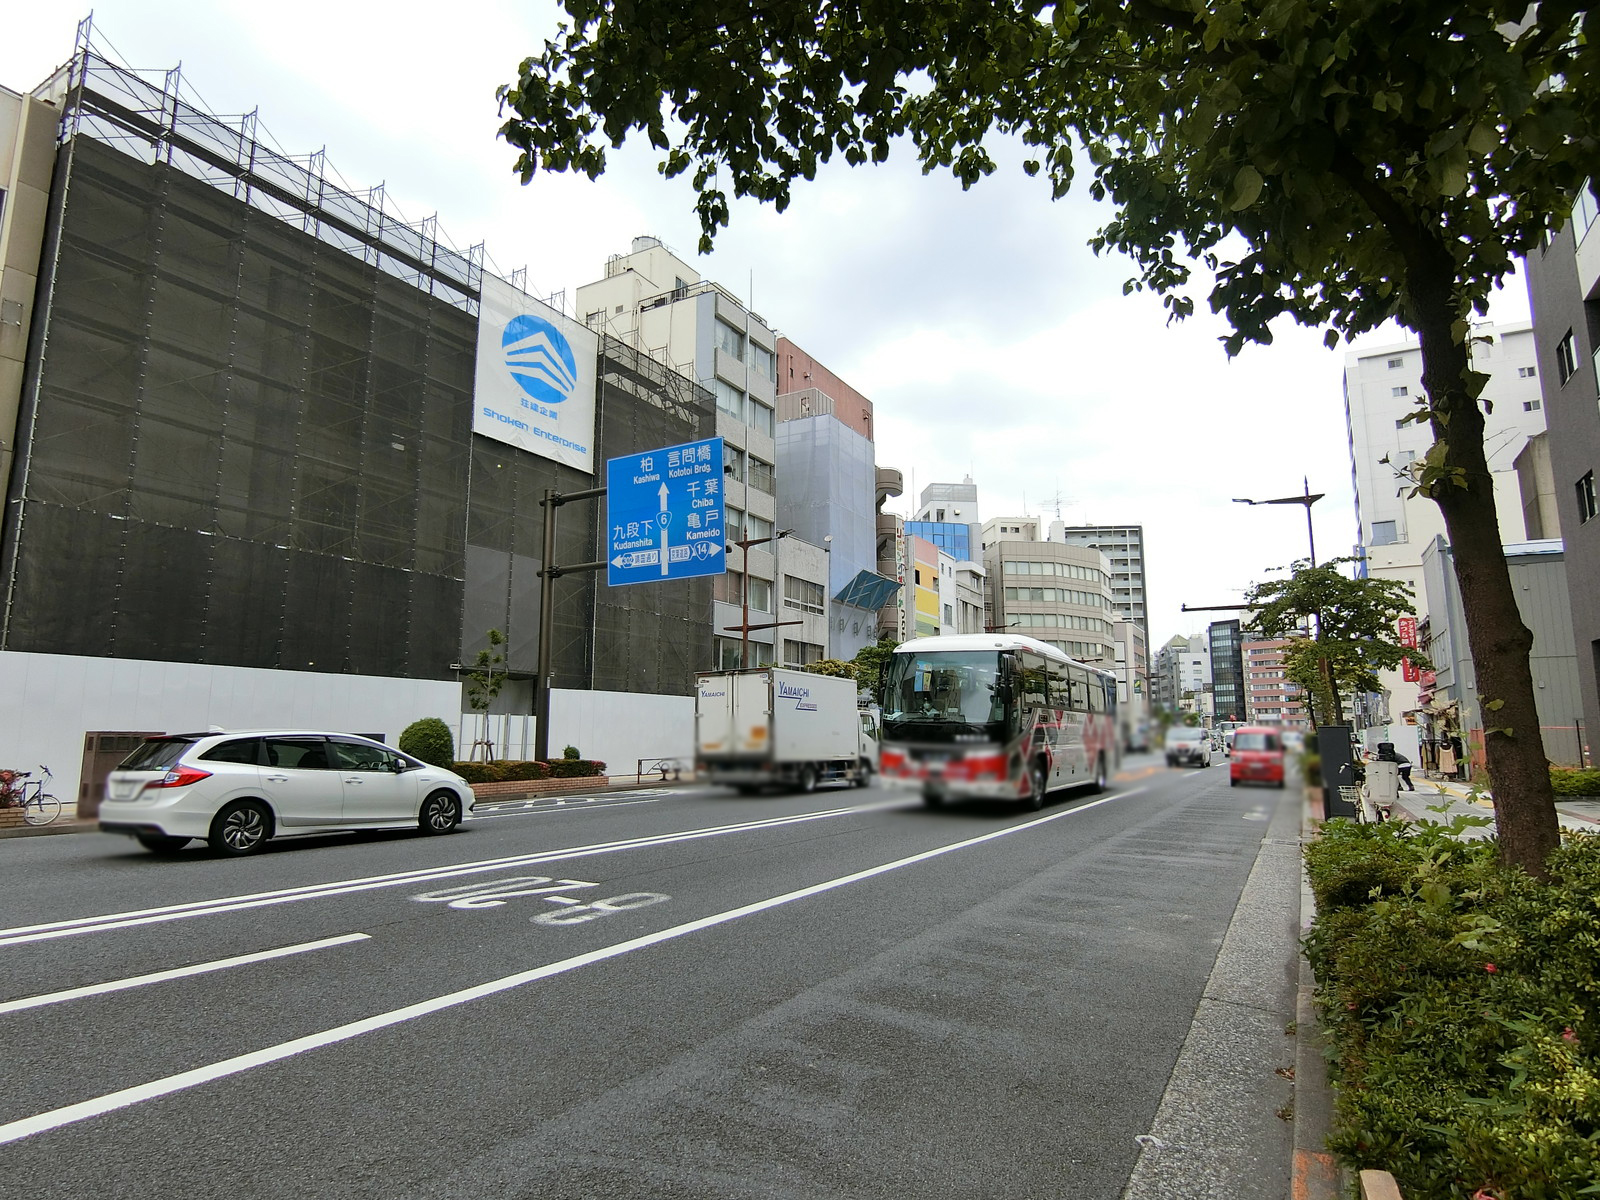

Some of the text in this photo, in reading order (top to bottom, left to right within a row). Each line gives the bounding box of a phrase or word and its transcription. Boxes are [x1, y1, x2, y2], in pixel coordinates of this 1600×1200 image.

[483, 407, 587, 455] Shoken Enterprise
[640, 444, 711, 473] 柏 言問橋
[633, 463, 712, 485] Kashiwa Kototoi Brdg.
[687, 478, 719, 497] 千葉
[691, 498, 714, 509] Chiba
[661, 514, 667, 525] 6
[687, 509, 719, 529] 亀戸
[613, 519, 654, 541] 九段下
[686, 527, 721, 541] Kameido
[613, 538, 653, 551] Kudanshita
[697, 543, 707, 554] 14
[701, 690, 726, 698] YAMAICHI
[778, 681, 810, 698] YAMAICHI
